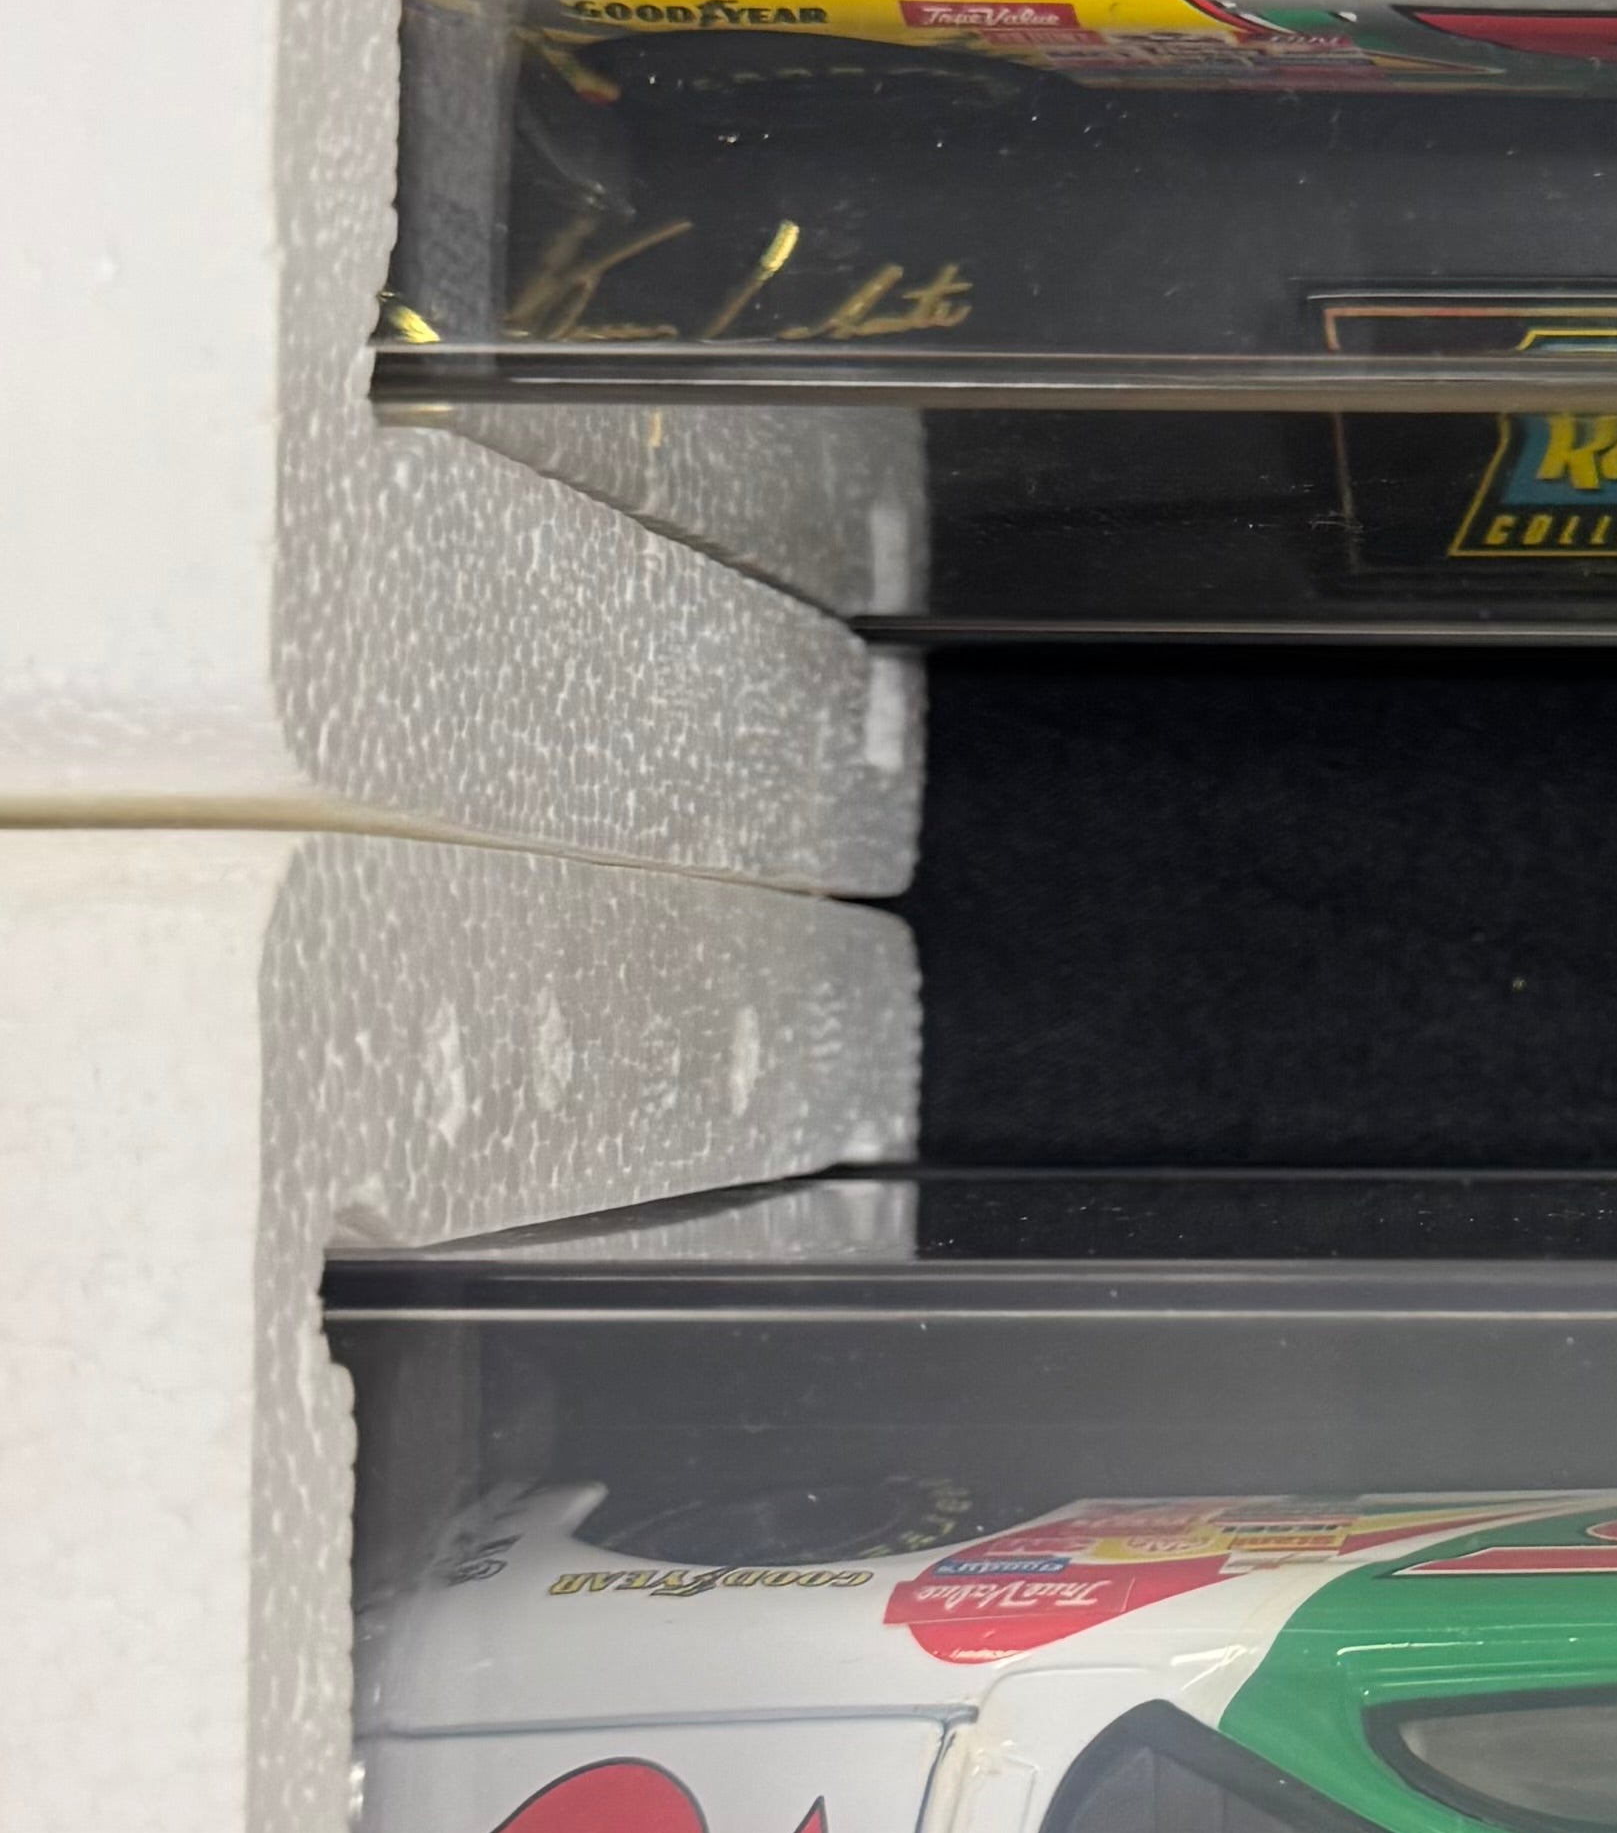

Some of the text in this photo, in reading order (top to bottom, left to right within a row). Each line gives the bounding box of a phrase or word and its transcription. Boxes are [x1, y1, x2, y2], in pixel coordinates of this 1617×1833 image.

[550, 1564, 873, 1599] GOODYEAR
[915, 1579, 1113, 1611] True Value
